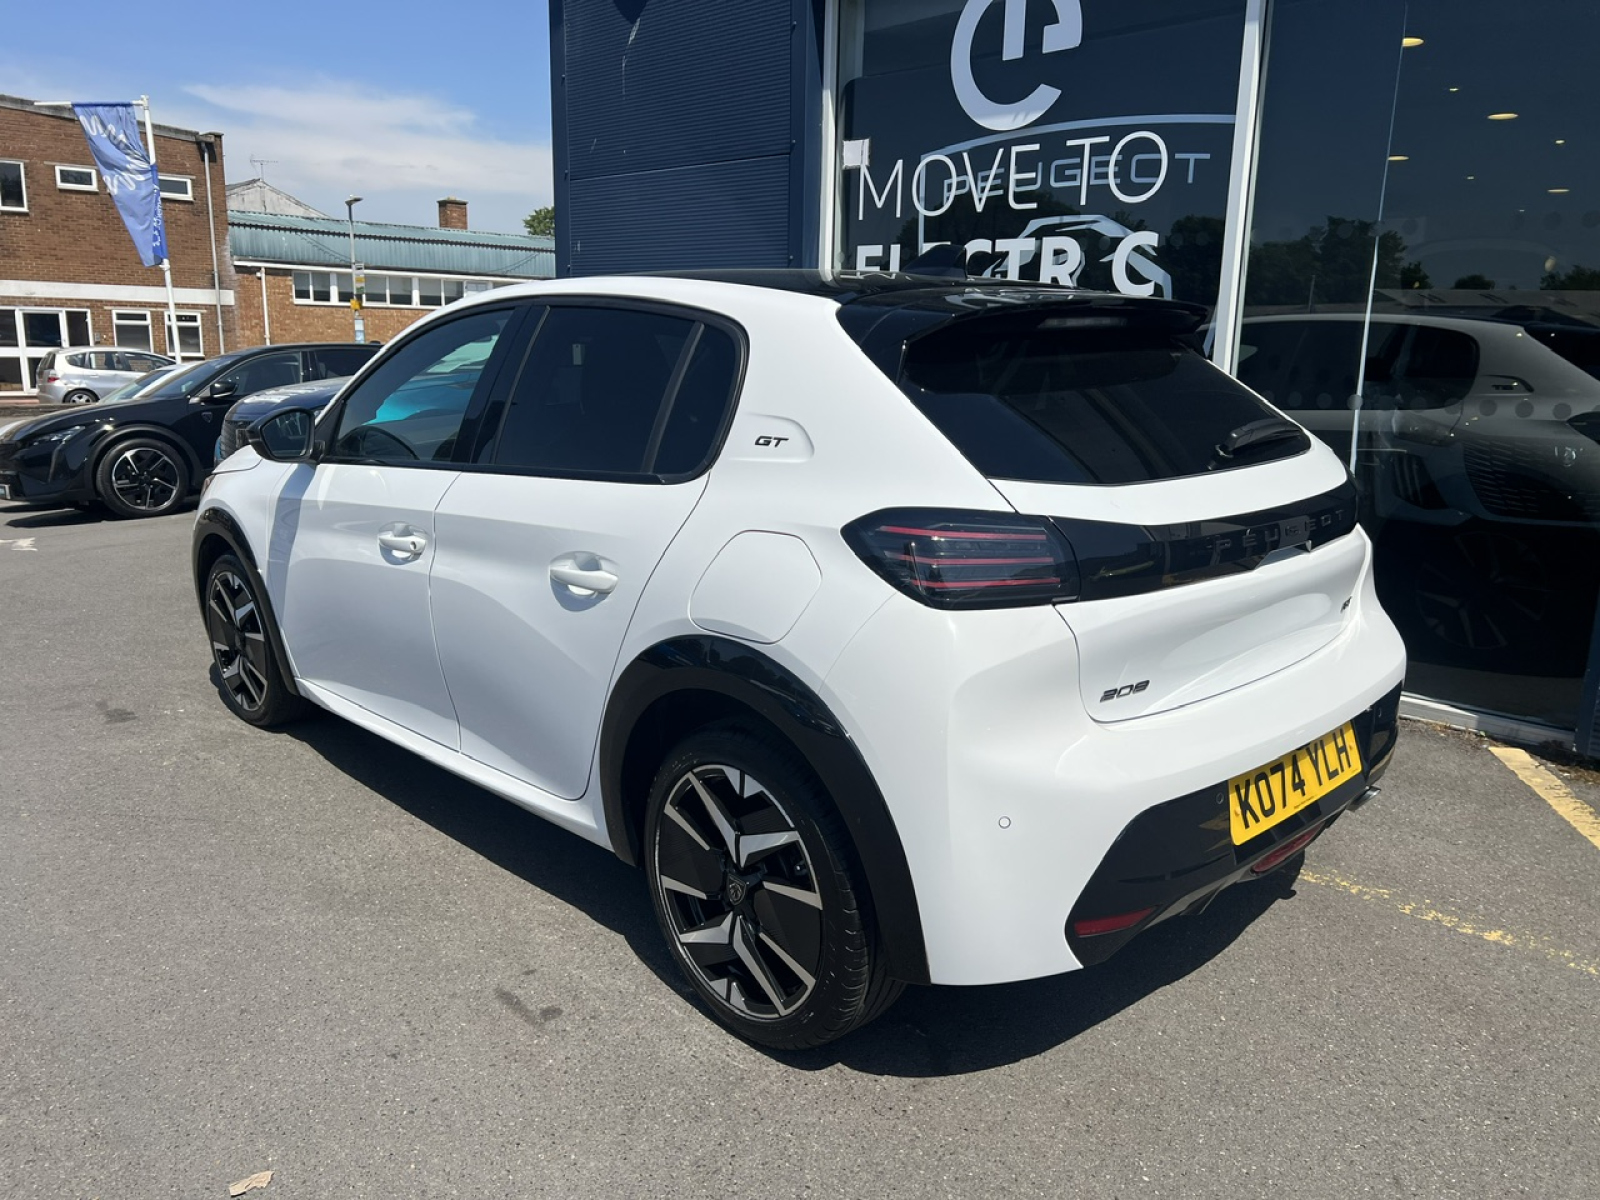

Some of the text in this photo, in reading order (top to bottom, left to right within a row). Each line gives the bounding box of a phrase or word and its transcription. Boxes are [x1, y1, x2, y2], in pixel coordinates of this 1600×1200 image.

[858, 131, 1169, 221] MOVE TO
[943, 153, 1211, 203] PEUGEOT
[857, 230, 1160, 297] ECTRC
[754, 435, 790, 448] GT
[1214, 509, 1347, 554] PEUGEOT
[1099, 679, 1150, 703] 208
[1306, 728, 1353, 787] YLH
